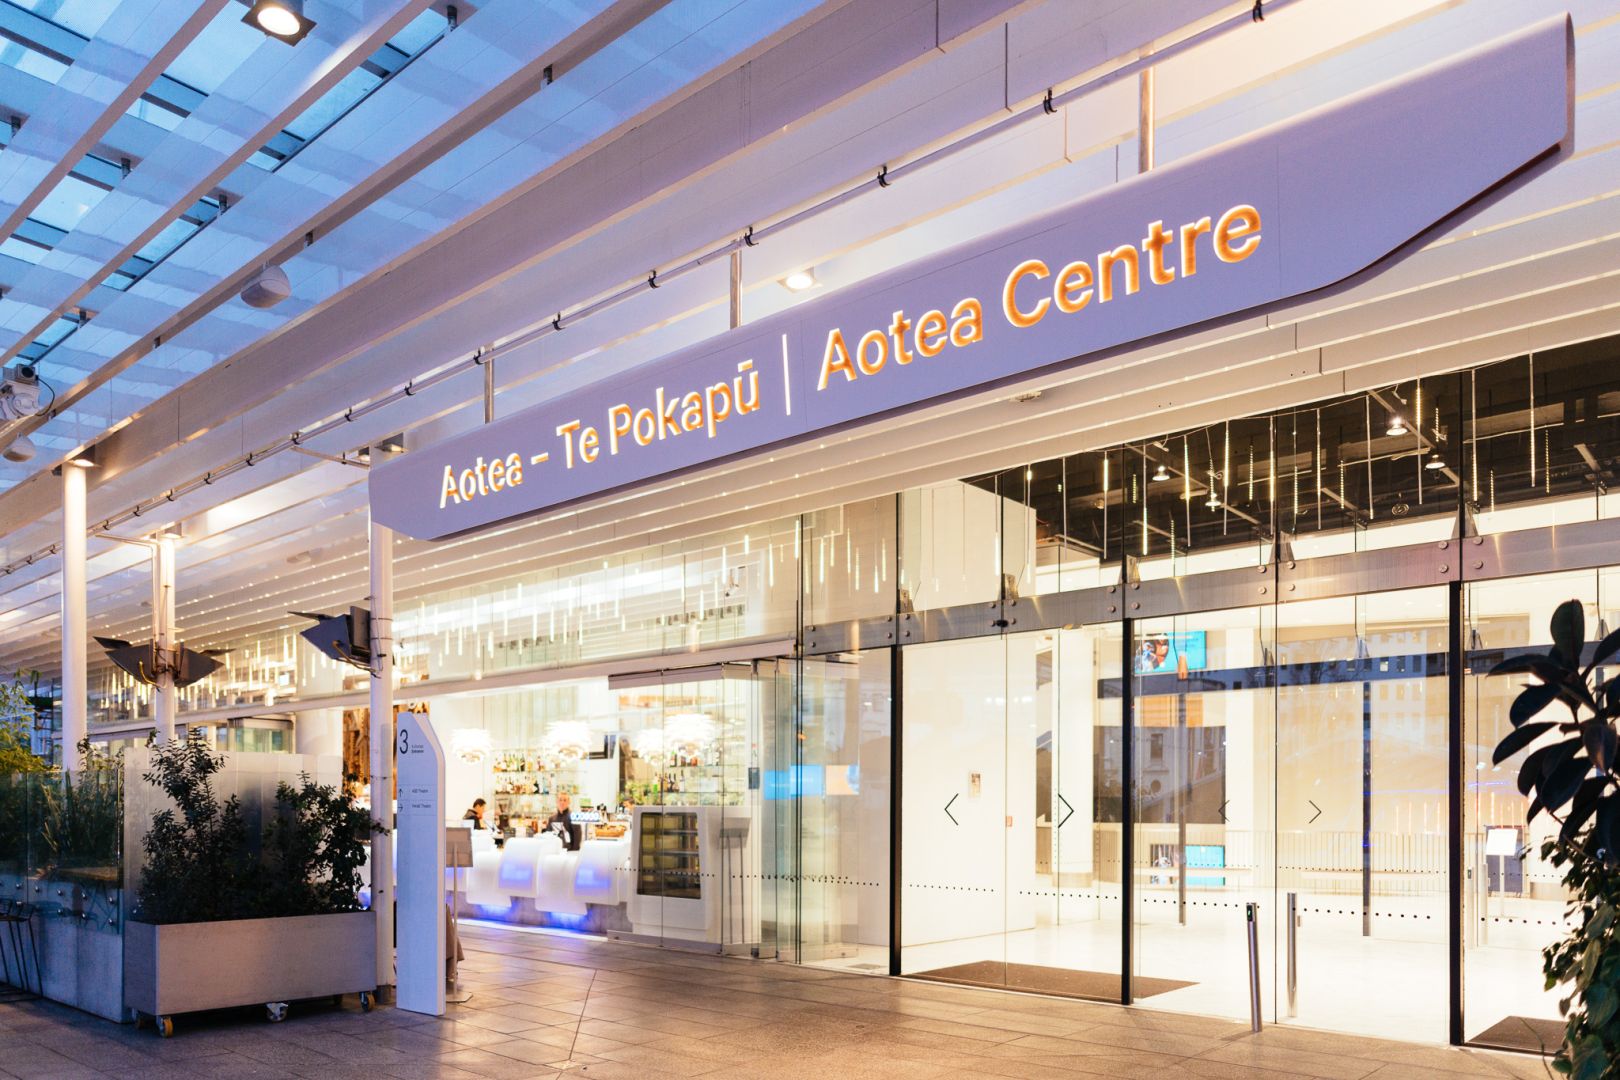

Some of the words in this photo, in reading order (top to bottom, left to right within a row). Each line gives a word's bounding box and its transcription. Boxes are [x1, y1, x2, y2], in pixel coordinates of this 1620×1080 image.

[439, 453, 523, 509] Aotea
[556, 419, 600, 469] Te
[608, 359, 761, 456] Pokapū
[816, 296, 984, 391] Aotea
[1002, 204, 1262, 328] Centre
[399, 729, 409, 755] 3
